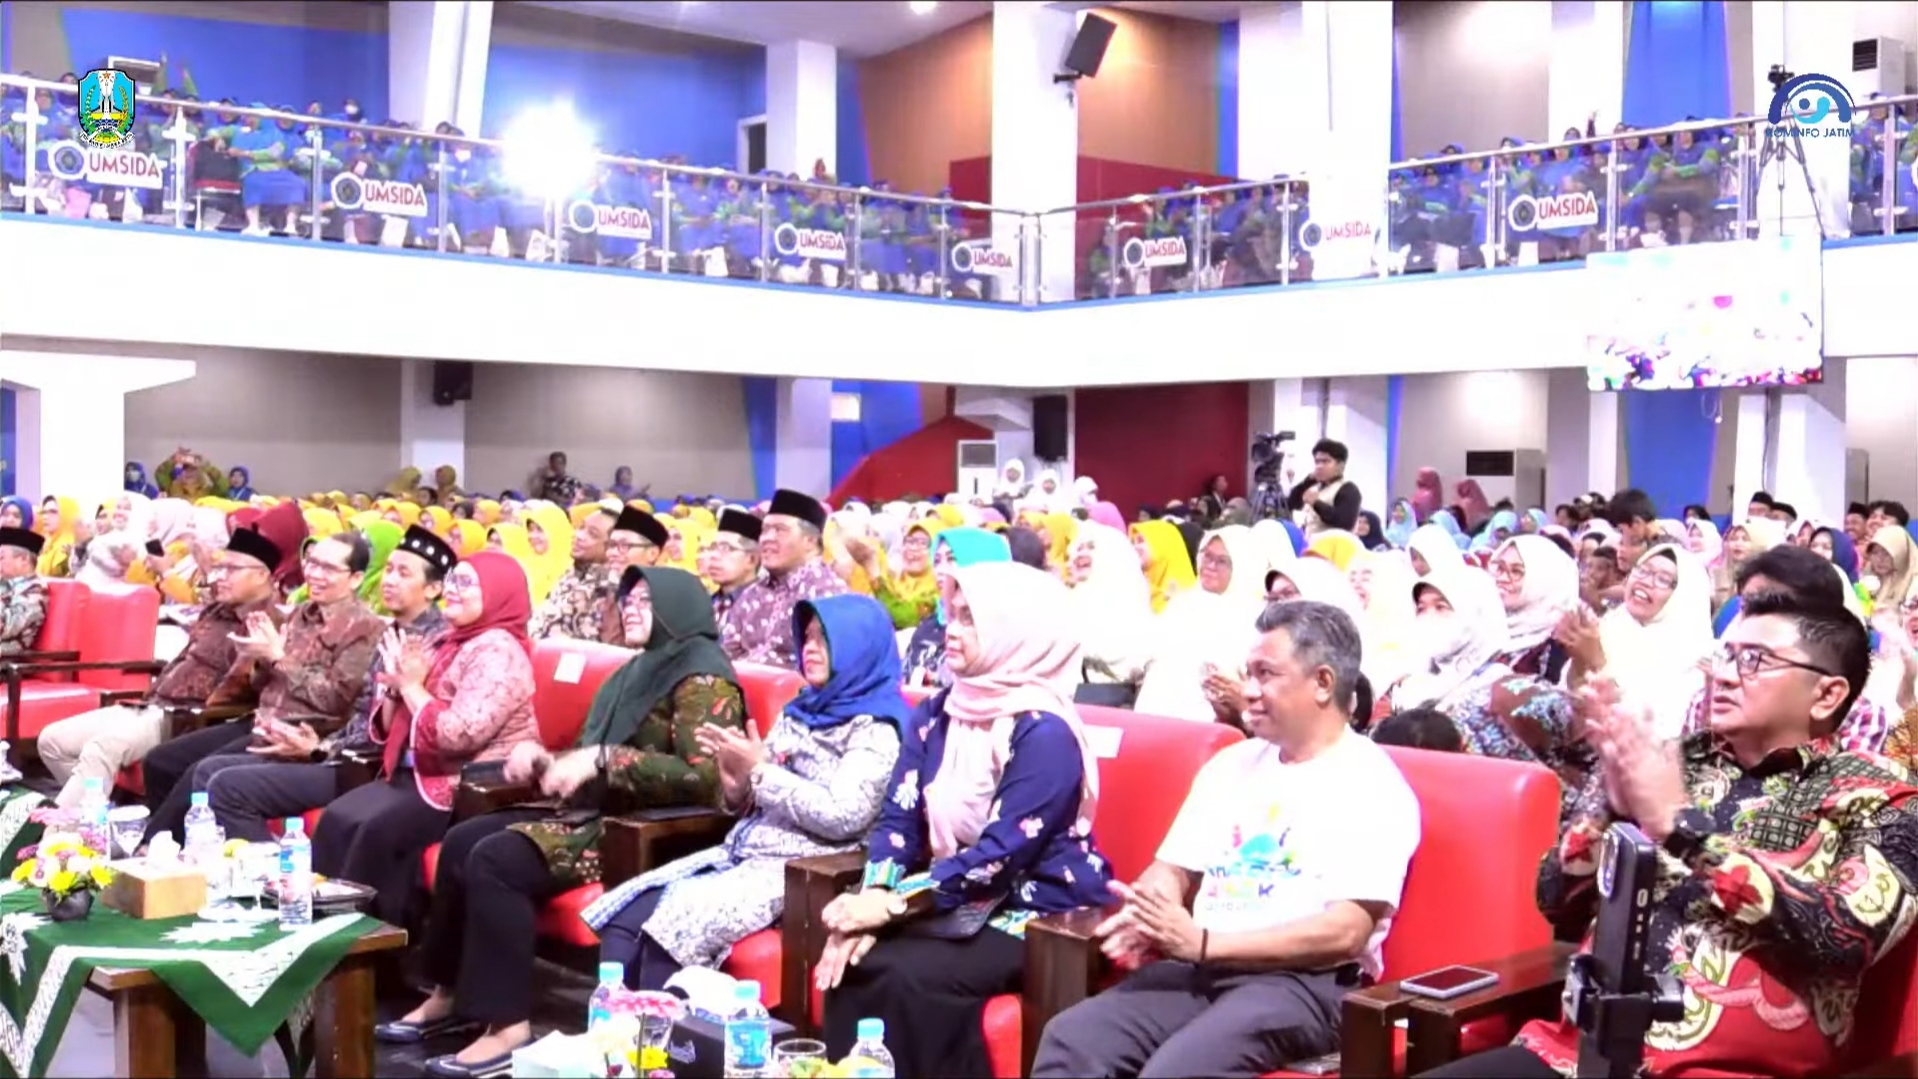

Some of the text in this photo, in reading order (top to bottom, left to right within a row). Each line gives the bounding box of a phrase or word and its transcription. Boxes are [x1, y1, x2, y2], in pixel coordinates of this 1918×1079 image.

[89, 152, 160, 178] UMSIDA
[365, 183, 425, 206] UMSIDA
[1539, 197, 1596, 219] UMSIDA
[598, 209, 650, 230] UMSIDA
[800, 232, 845, 251] UMSIDA
